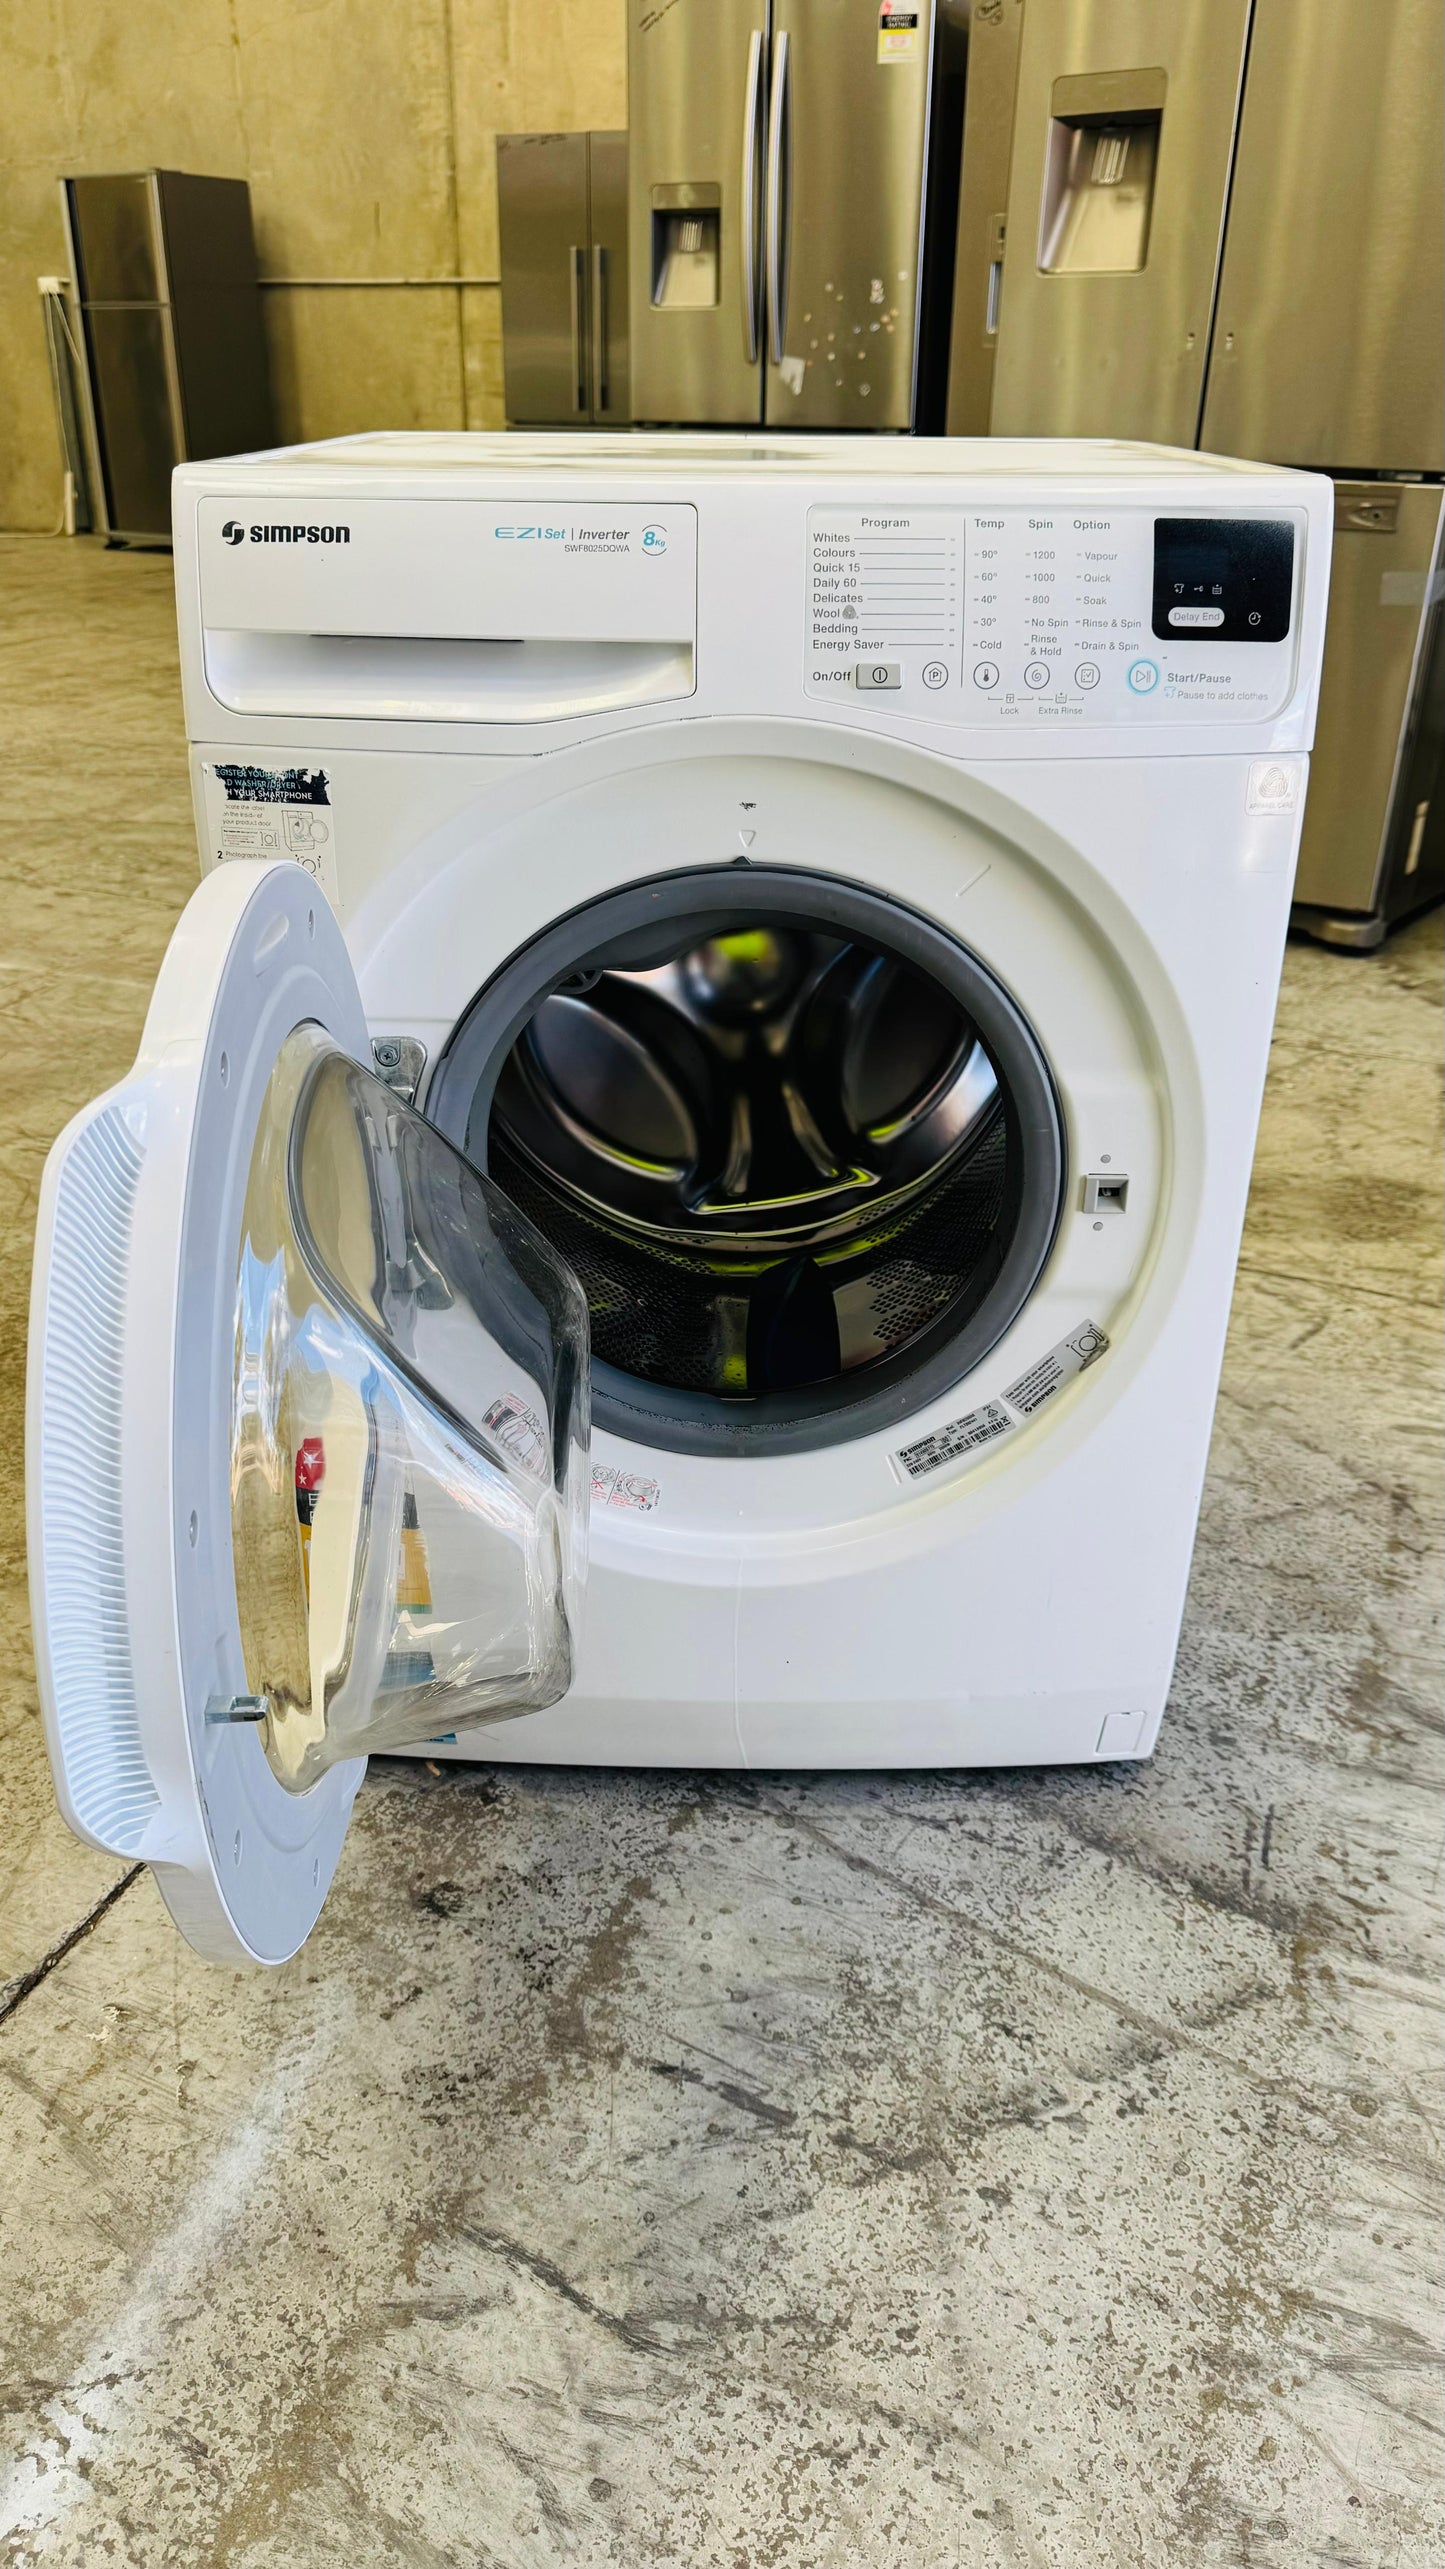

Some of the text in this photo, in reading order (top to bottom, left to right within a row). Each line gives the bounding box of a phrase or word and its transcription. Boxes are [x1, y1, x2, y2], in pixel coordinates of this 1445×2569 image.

[862, 518, 909, 529] Program
[974, 519, 1004, 529] Temp
[1029, 519, 1053, 530] Spin
[1073, 520, 1110, 531] Option
[250, 525, 350, 543] SIMPSON
[579, 529, 630, 539] Inverter
[813, 533, 850, 542] Whites
[814, 548, 855, 557] Colours
[1034, 551, 1055, 559] 1200
[1085, 552, 1117, 562] Vapour
[813, 563, 860, 572] Quick 15
[1034, 573, 1055, 582] 1000
[1084, 573, 1110, 582] Quick
[814, 578, 856, 590] Daily 60
[814, 593, 863, 602] Delicates
[1033, 595, 1049, 604] 800
[1084, 596, 1107, 605] Soak
[813, 608, 839, 618] Wool
[1174, 612, 1220, 623] Delay End
[1032, 618, 1068, 628] No Spin
[1083, 619, 1141, 629] Rinse & Spin
[813, 624, 857, 635] Bedding
[1031, 635, 1057, 643] Rinse
[813, 640, 884, 651] Energy Saver
[980, 641, 1001, 649] Cold
[1082, 641, 1139, 652] Drain & Spin
[1031, 647, 1061, 655] & Hold
[813, 672, 851, 681] On/Off
[1168, 673, 1231, 683] Start/Pause
[1178, 691, 1268, 701] Pause to add clothes
[215, 768, 246, 777] EGISTER
[258, 790, 313, 800] SMARTPHONE
[218, 851, 223, 859] 2
